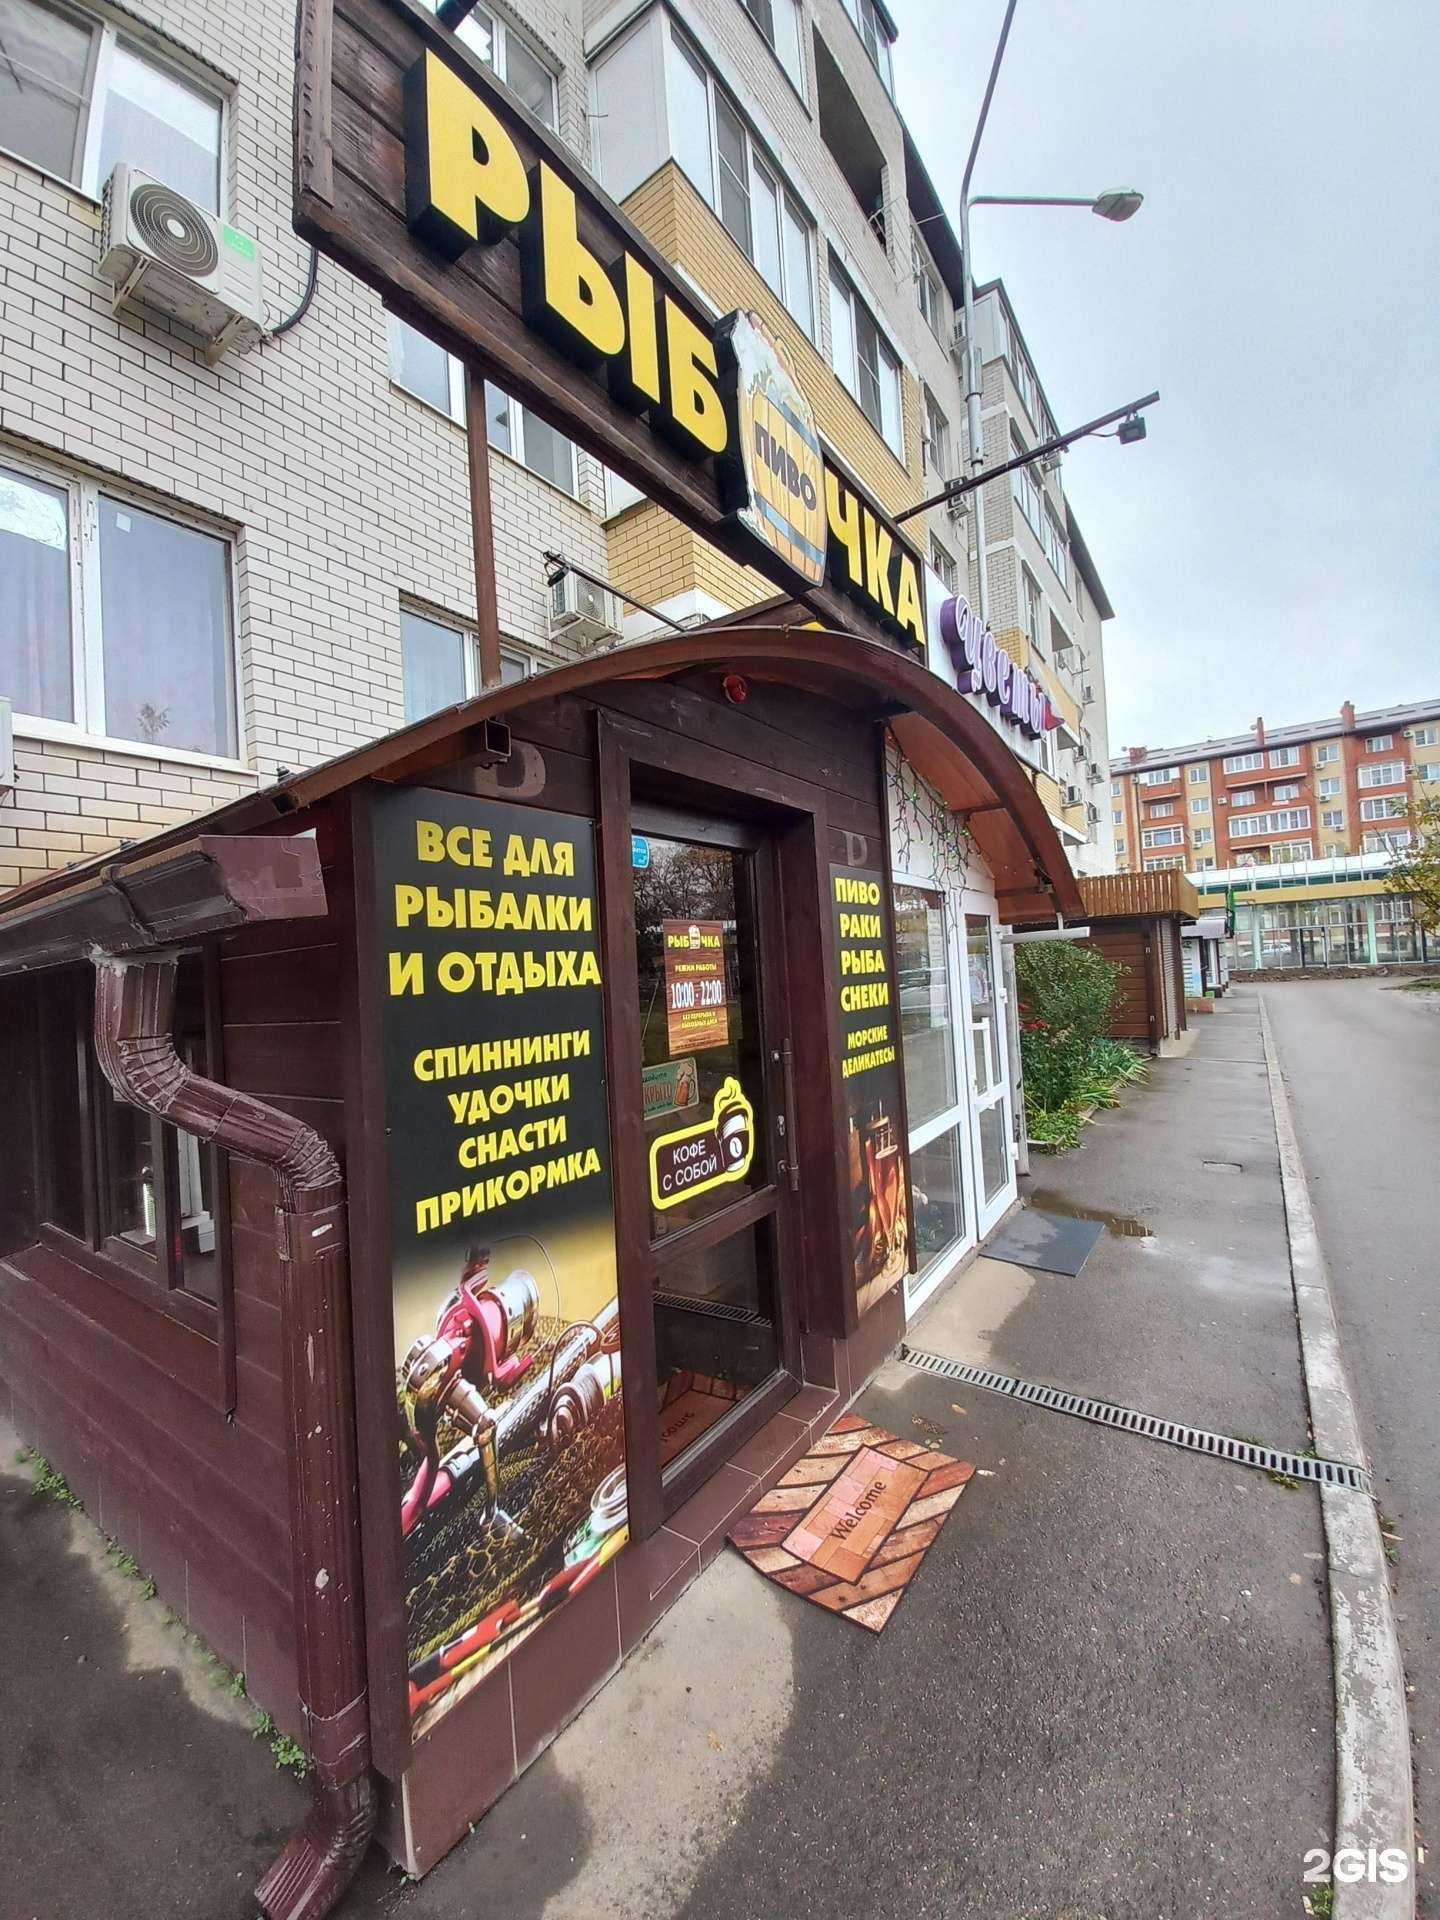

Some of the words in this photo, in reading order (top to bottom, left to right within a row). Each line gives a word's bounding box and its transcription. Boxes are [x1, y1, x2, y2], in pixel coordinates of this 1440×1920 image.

[755, 421, 817, 511] ПИВО
[416, 819, 494, 869] ВСЕ
[503, 834, 575, 877] ДЛЯ
[394, 883, 593, 932] РЫБАЛКИ
[834, 877, 880, 906] ПИВО
[839, 913, 881, 938] РАКИ
[389, 951, 425, 996] И
[437, 951, 602, 996] ОТДЫХА
[841, 950, 886, 976] РЫБА
[671, 981, 695, 1009] 10:00
[701, 979, 722, 1006] 22:00
[840, 982, 889, 1012] СНЕКИ
[413, 1029, 591, 1082] СПИННИНГИ
[847, 1025, 888, 1050] МОРСКИЕ
[842, 1045, 895, 1079] ДЕЛИКАТЕСЫ
[447, 1072, 570, 1125] УДОЧКИ
[458, 1115, 567, 1169] СНАСТИ
[672, 1138, 706, 1165] КОФЕ
[415, 1148, 601, 1234] ПРИКОРМКА
[662, 1174, 672, 1191] С
[675, 1152, 717, 1186] СОБОЙ
[829, 1480, 887, 1541] Welcome
